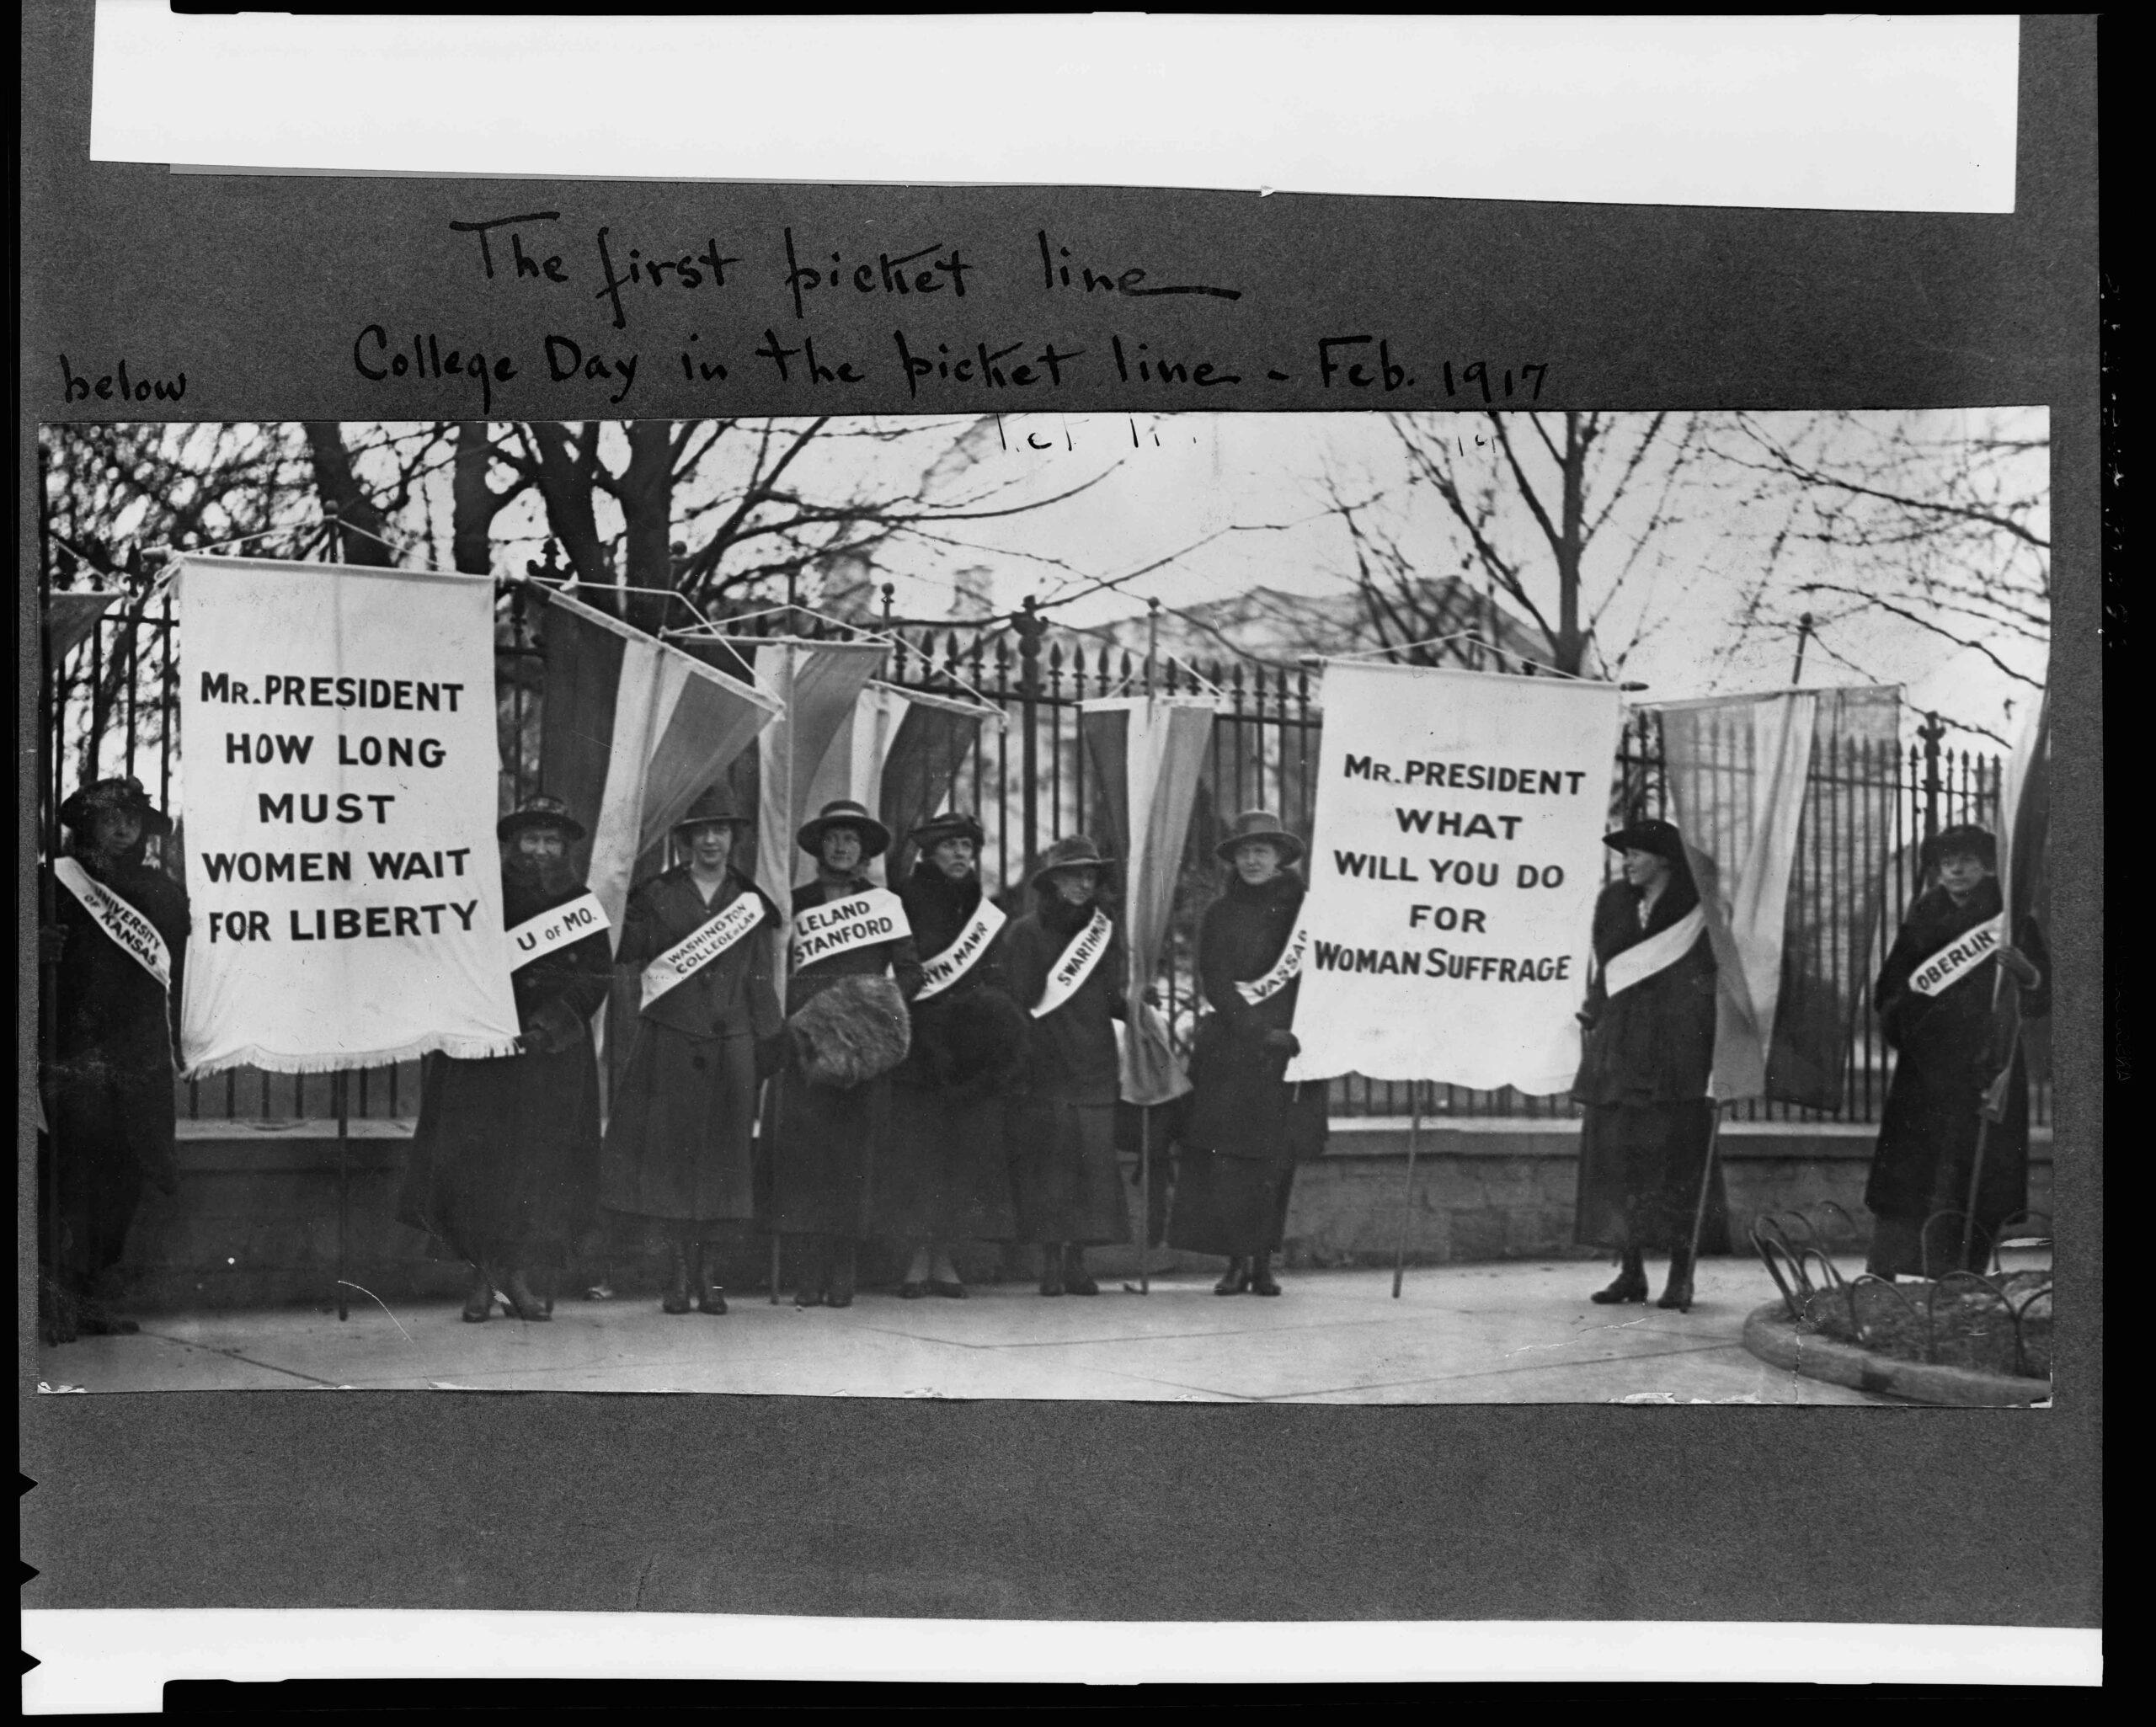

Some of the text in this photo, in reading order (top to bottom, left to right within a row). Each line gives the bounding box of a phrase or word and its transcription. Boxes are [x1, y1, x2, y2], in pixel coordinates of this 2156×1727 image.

[450, 211, 1241, 329] The first picket line
[60, 354, 186, 402] below
[354, 324, 518, 413] College
[544, 335, 638, 403] Day
[681, 333, 728, 381] in
[755, 328, 865, 385] the
[894, 330, 1085, 400] picket
[1112, 335, 1241, 386] line
[1318, 334, 1416, 392] Feb.
[1443, 360, 1548, 402] 1917
[265, 674, 464, 712] PRESIDENT
[226, 733, 446, 768] HOW LONG
[1405, 760, 1586, 795] PRESIDENT
[259, 793, 395, 824] MUST
[1396, 808, 1523, 840] WHAT
[201, 847, 471, 882] WOMEN WAIT
[1334, 850, 1565, 888] WILL YOU DO
[83, 893, 158, 967] OF KANSAS
[95, 887, 161, 951] UNIVERSITY
[209, 899, 478, 943] FOR LIBERTY
[516, 907, 597, 951] U OF MO.
[667, 903, 747, 964] WASHINGTON
[794, 916, 894, 964] STANFORD
[796, 900, 871, 937] LELAND
[1410, 904, 1486, 933] FOR
[675, 929, 734, 974] COLLEGE
[921, 920, 989, 988] RYN MAWR
[1315, 941, 1572, 983] WOMAN SUFFRAGE
[1916, 930, 1996, 991] OBERLIN
